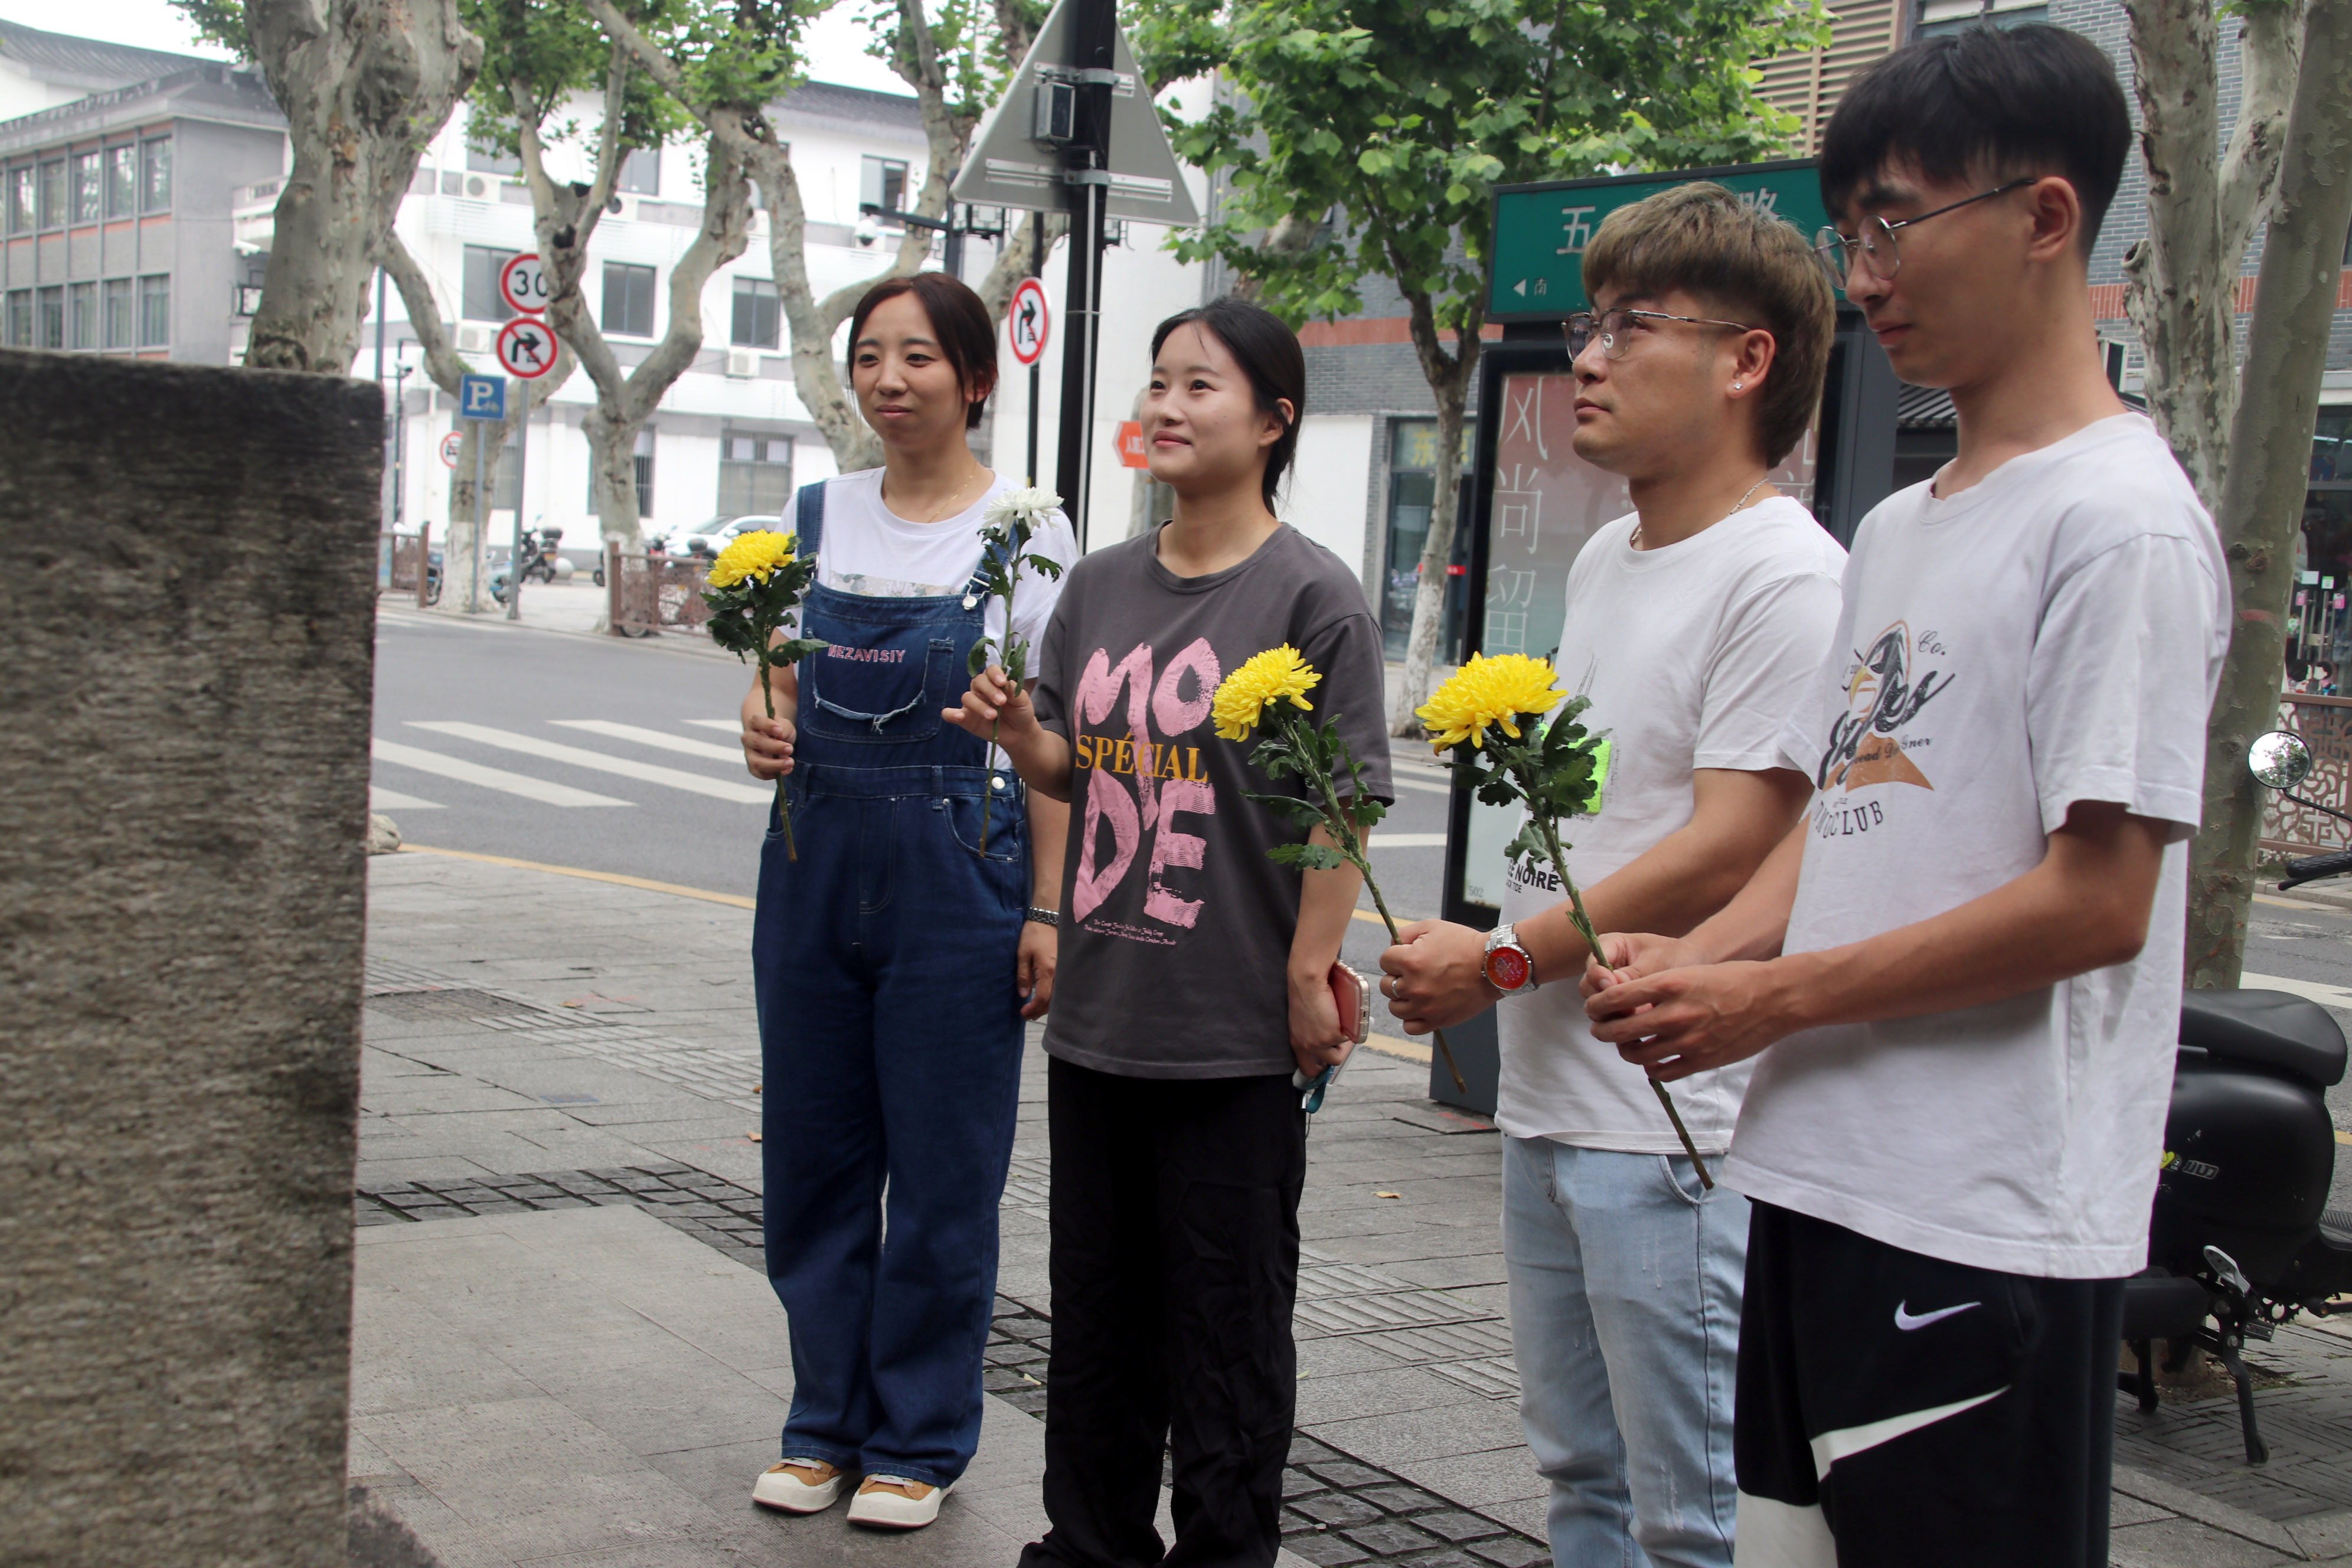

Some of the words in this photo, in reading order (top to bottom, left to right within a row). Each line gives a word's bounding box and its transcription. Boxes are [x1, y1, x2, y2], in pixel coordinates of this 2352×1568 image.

[513, 269, 548, 296] 30
[1534, 277, 1548, 295] 南
[467, 381, 494, 410] P
[1917, 629, 1948, 656] Co.
[1076, 733, 1208, 783] SPÉCIAL
